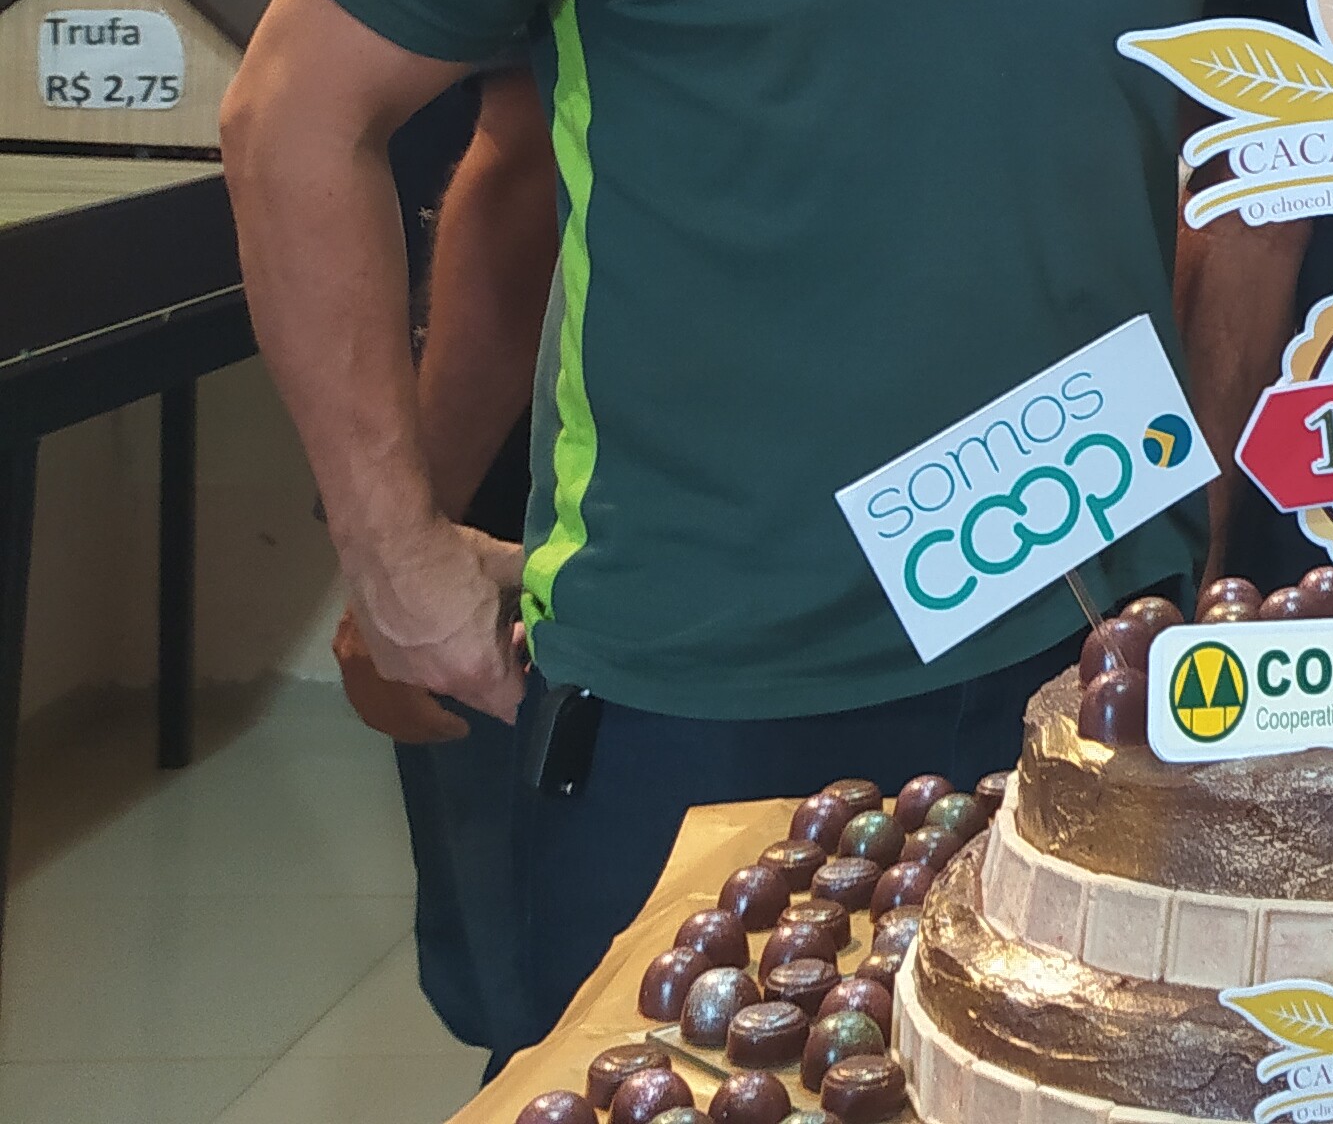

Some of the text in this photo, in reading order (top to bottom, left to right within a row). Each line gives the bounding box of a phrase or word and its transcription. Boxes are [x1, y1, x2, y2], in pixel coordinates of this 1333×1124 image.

[44, 17, 140, 46] Trufa
[46, 72, 179, 107] R$ 2,75
[1247, 201, 1265, 221] O
[868, 372, 1104, 539] somos
[904, 433, 1133, 611] coop
